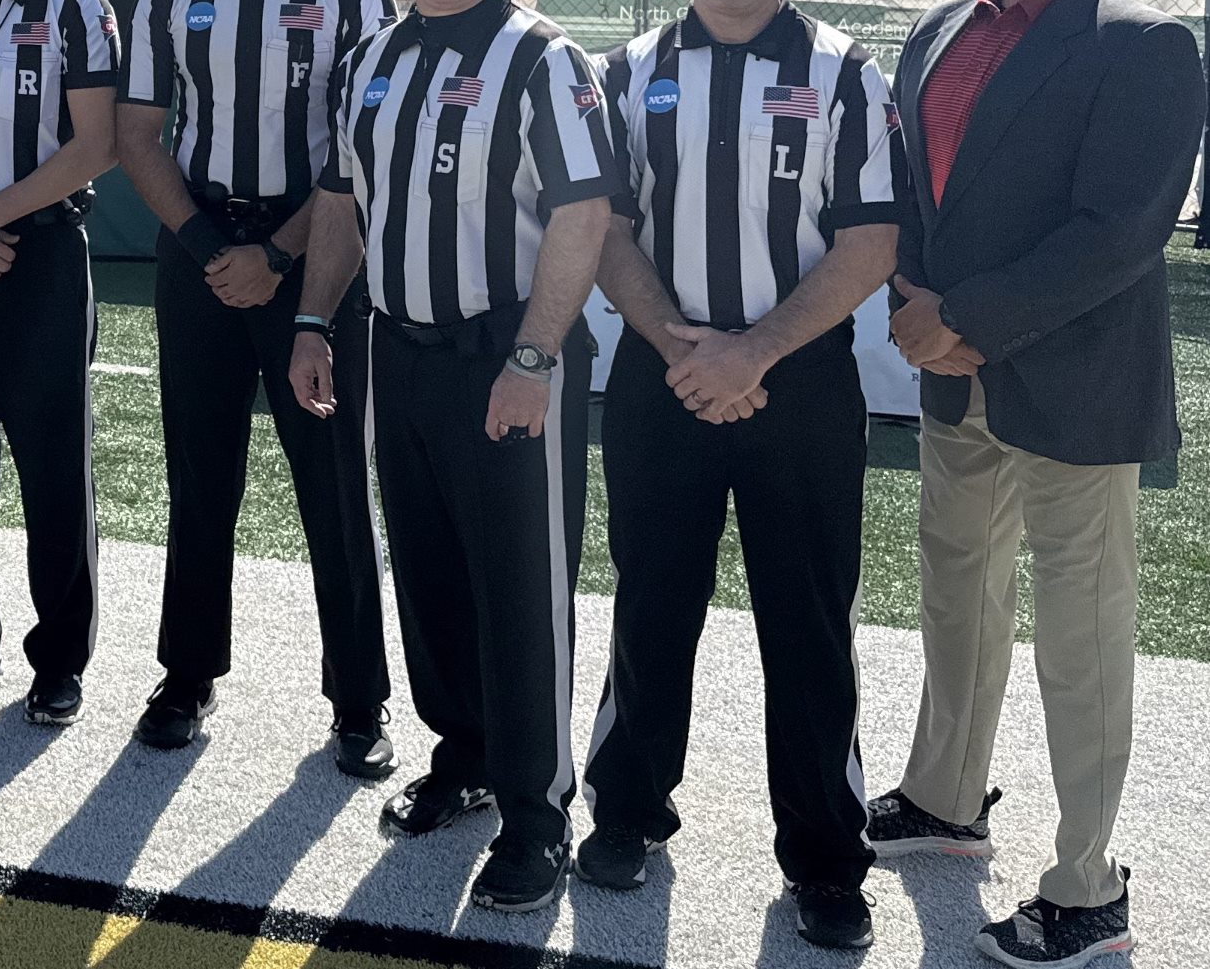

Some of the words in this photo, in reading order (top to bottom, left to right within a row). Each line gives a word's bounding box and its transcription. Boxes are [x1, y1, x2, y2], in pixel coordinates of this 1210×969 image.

[189, 14, 214, 24] NCAA
[619, 5, 670, 21] North
[837, 17, 911, 38] Academ
[18, 69, 38, 95] R
[291, 61, 309, 88] F
[365, 90, 385, 100] NCAA
[648, 93, 678, 105] NCAA
[435, 142, 456, 174] S
[774, 144, 799, 179] L
